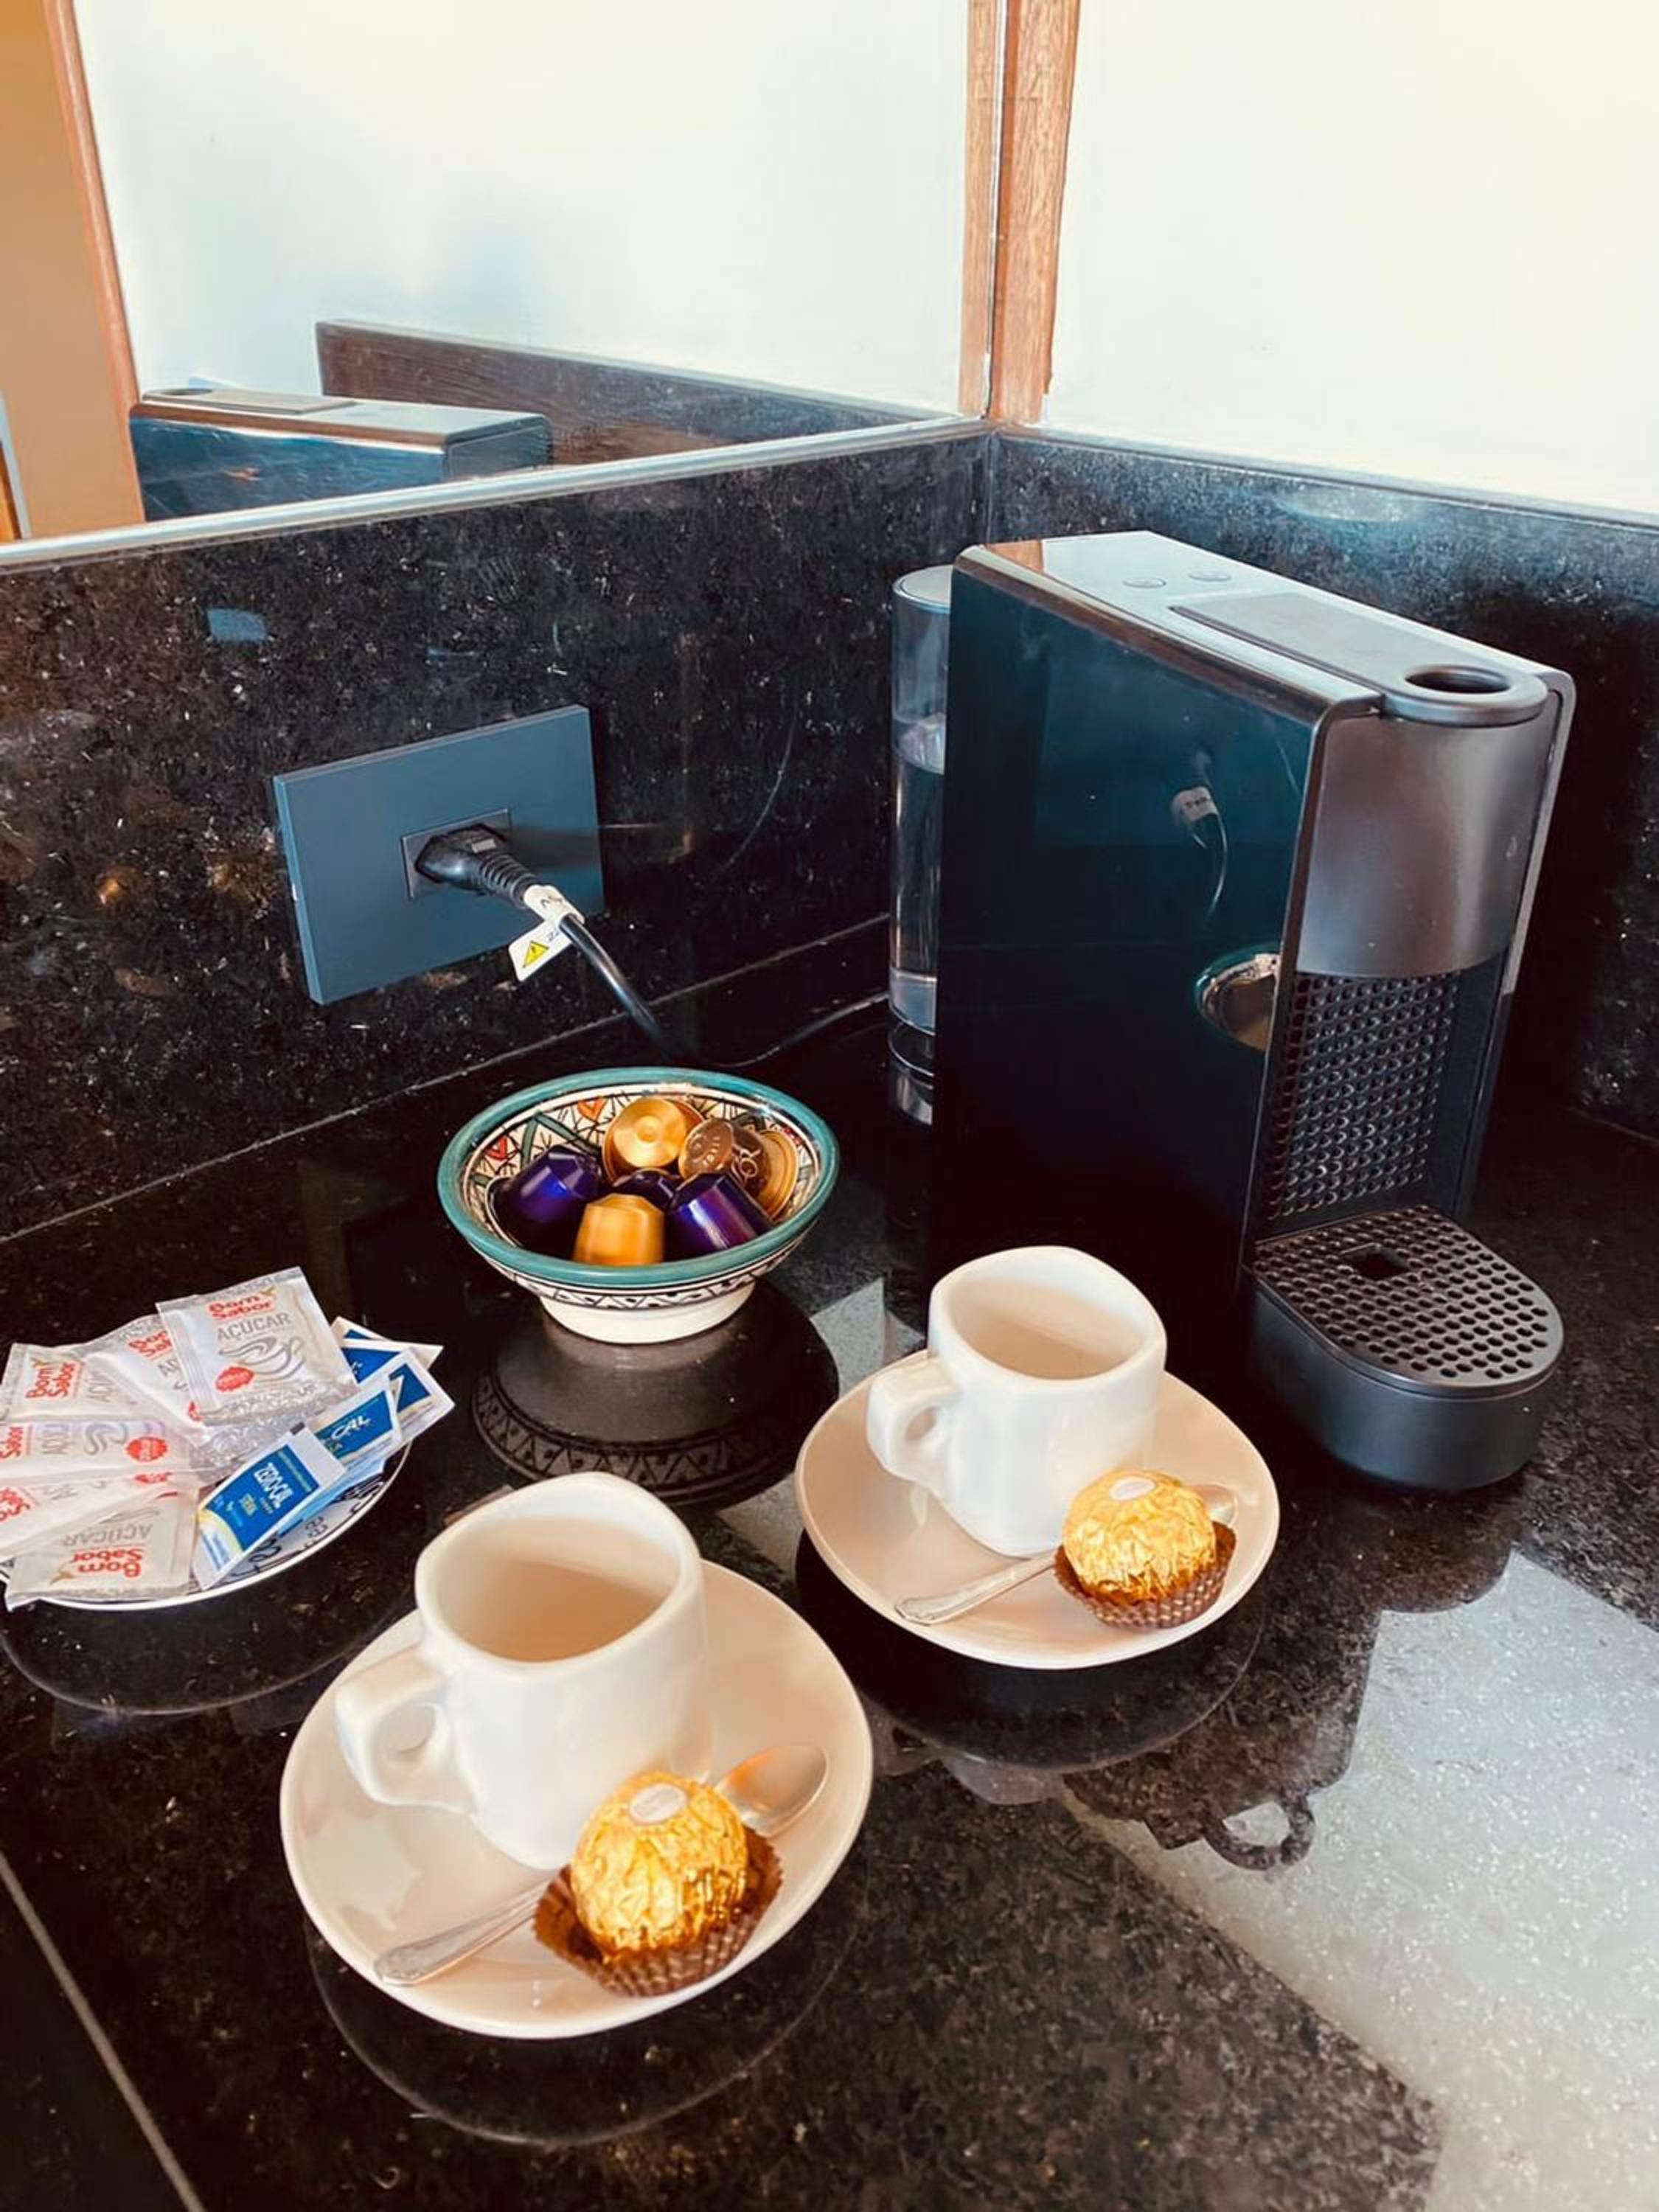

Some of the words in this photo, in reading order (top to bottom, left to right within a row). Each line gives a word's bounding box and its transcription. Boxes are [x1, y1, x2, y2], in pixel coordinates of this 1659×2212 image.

[209, 1295, 259, 1313] Bom
[212, 1301, 272, 1318] Sabor
[26, 1366, 53, 1399] Bom
[46, 1360, 76, 1398] Sabor
[70, 1549, 144, 1564] Sabor
[78, 1561, 142, 1578] Bom
